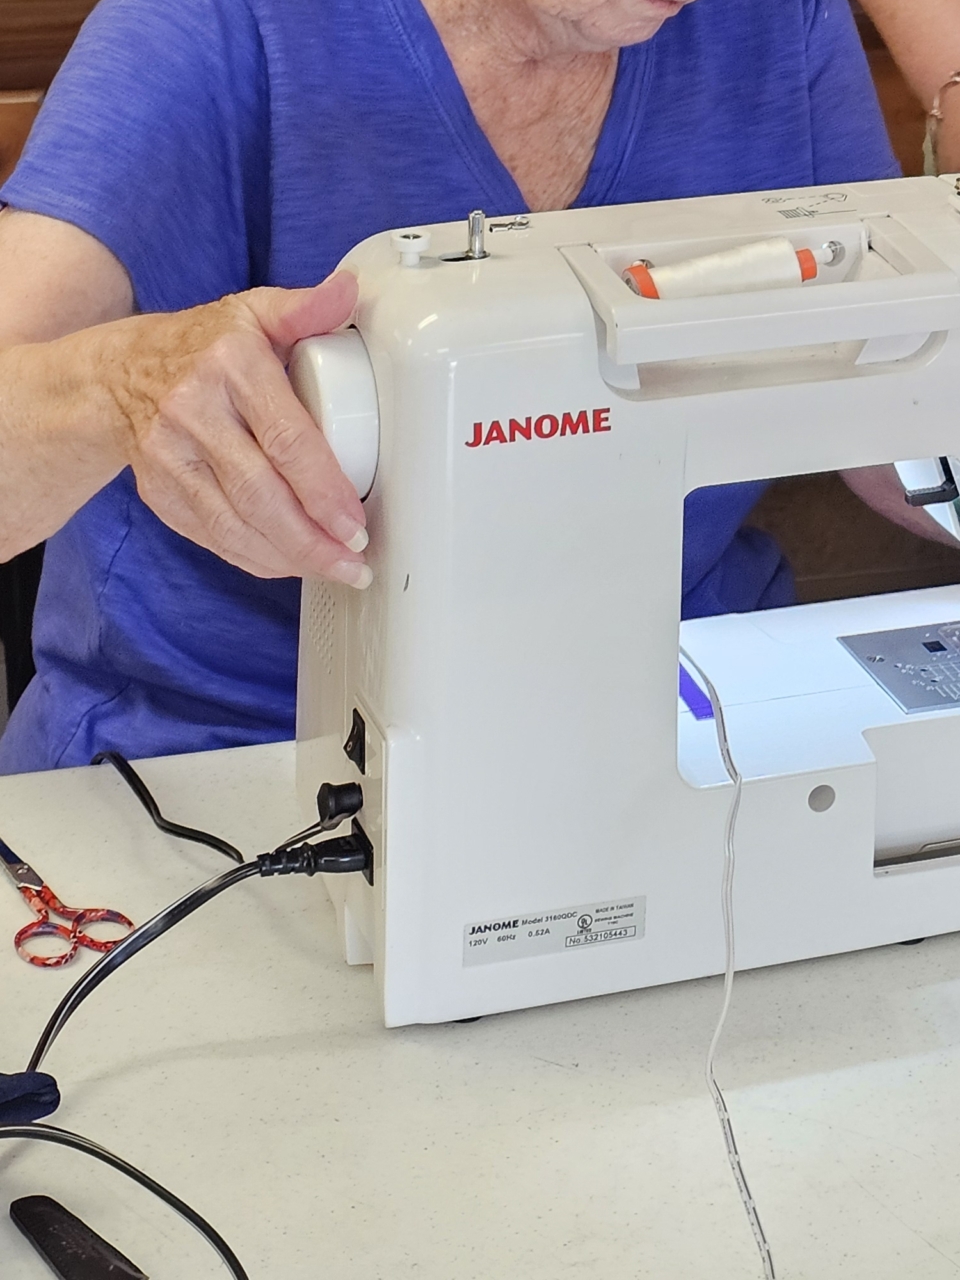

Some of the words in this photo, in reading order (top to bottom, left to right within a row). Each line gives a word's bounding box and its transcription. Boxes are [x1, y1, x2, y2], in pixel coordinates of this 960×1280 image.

[465, 408, 611, 447] JANOME
[469, 919, 519, 936] JANOME
[521, 918, 543, 926] Model
[468, 938, 488, 948] 120V
[497, 934, 516, 943] 60Hz
